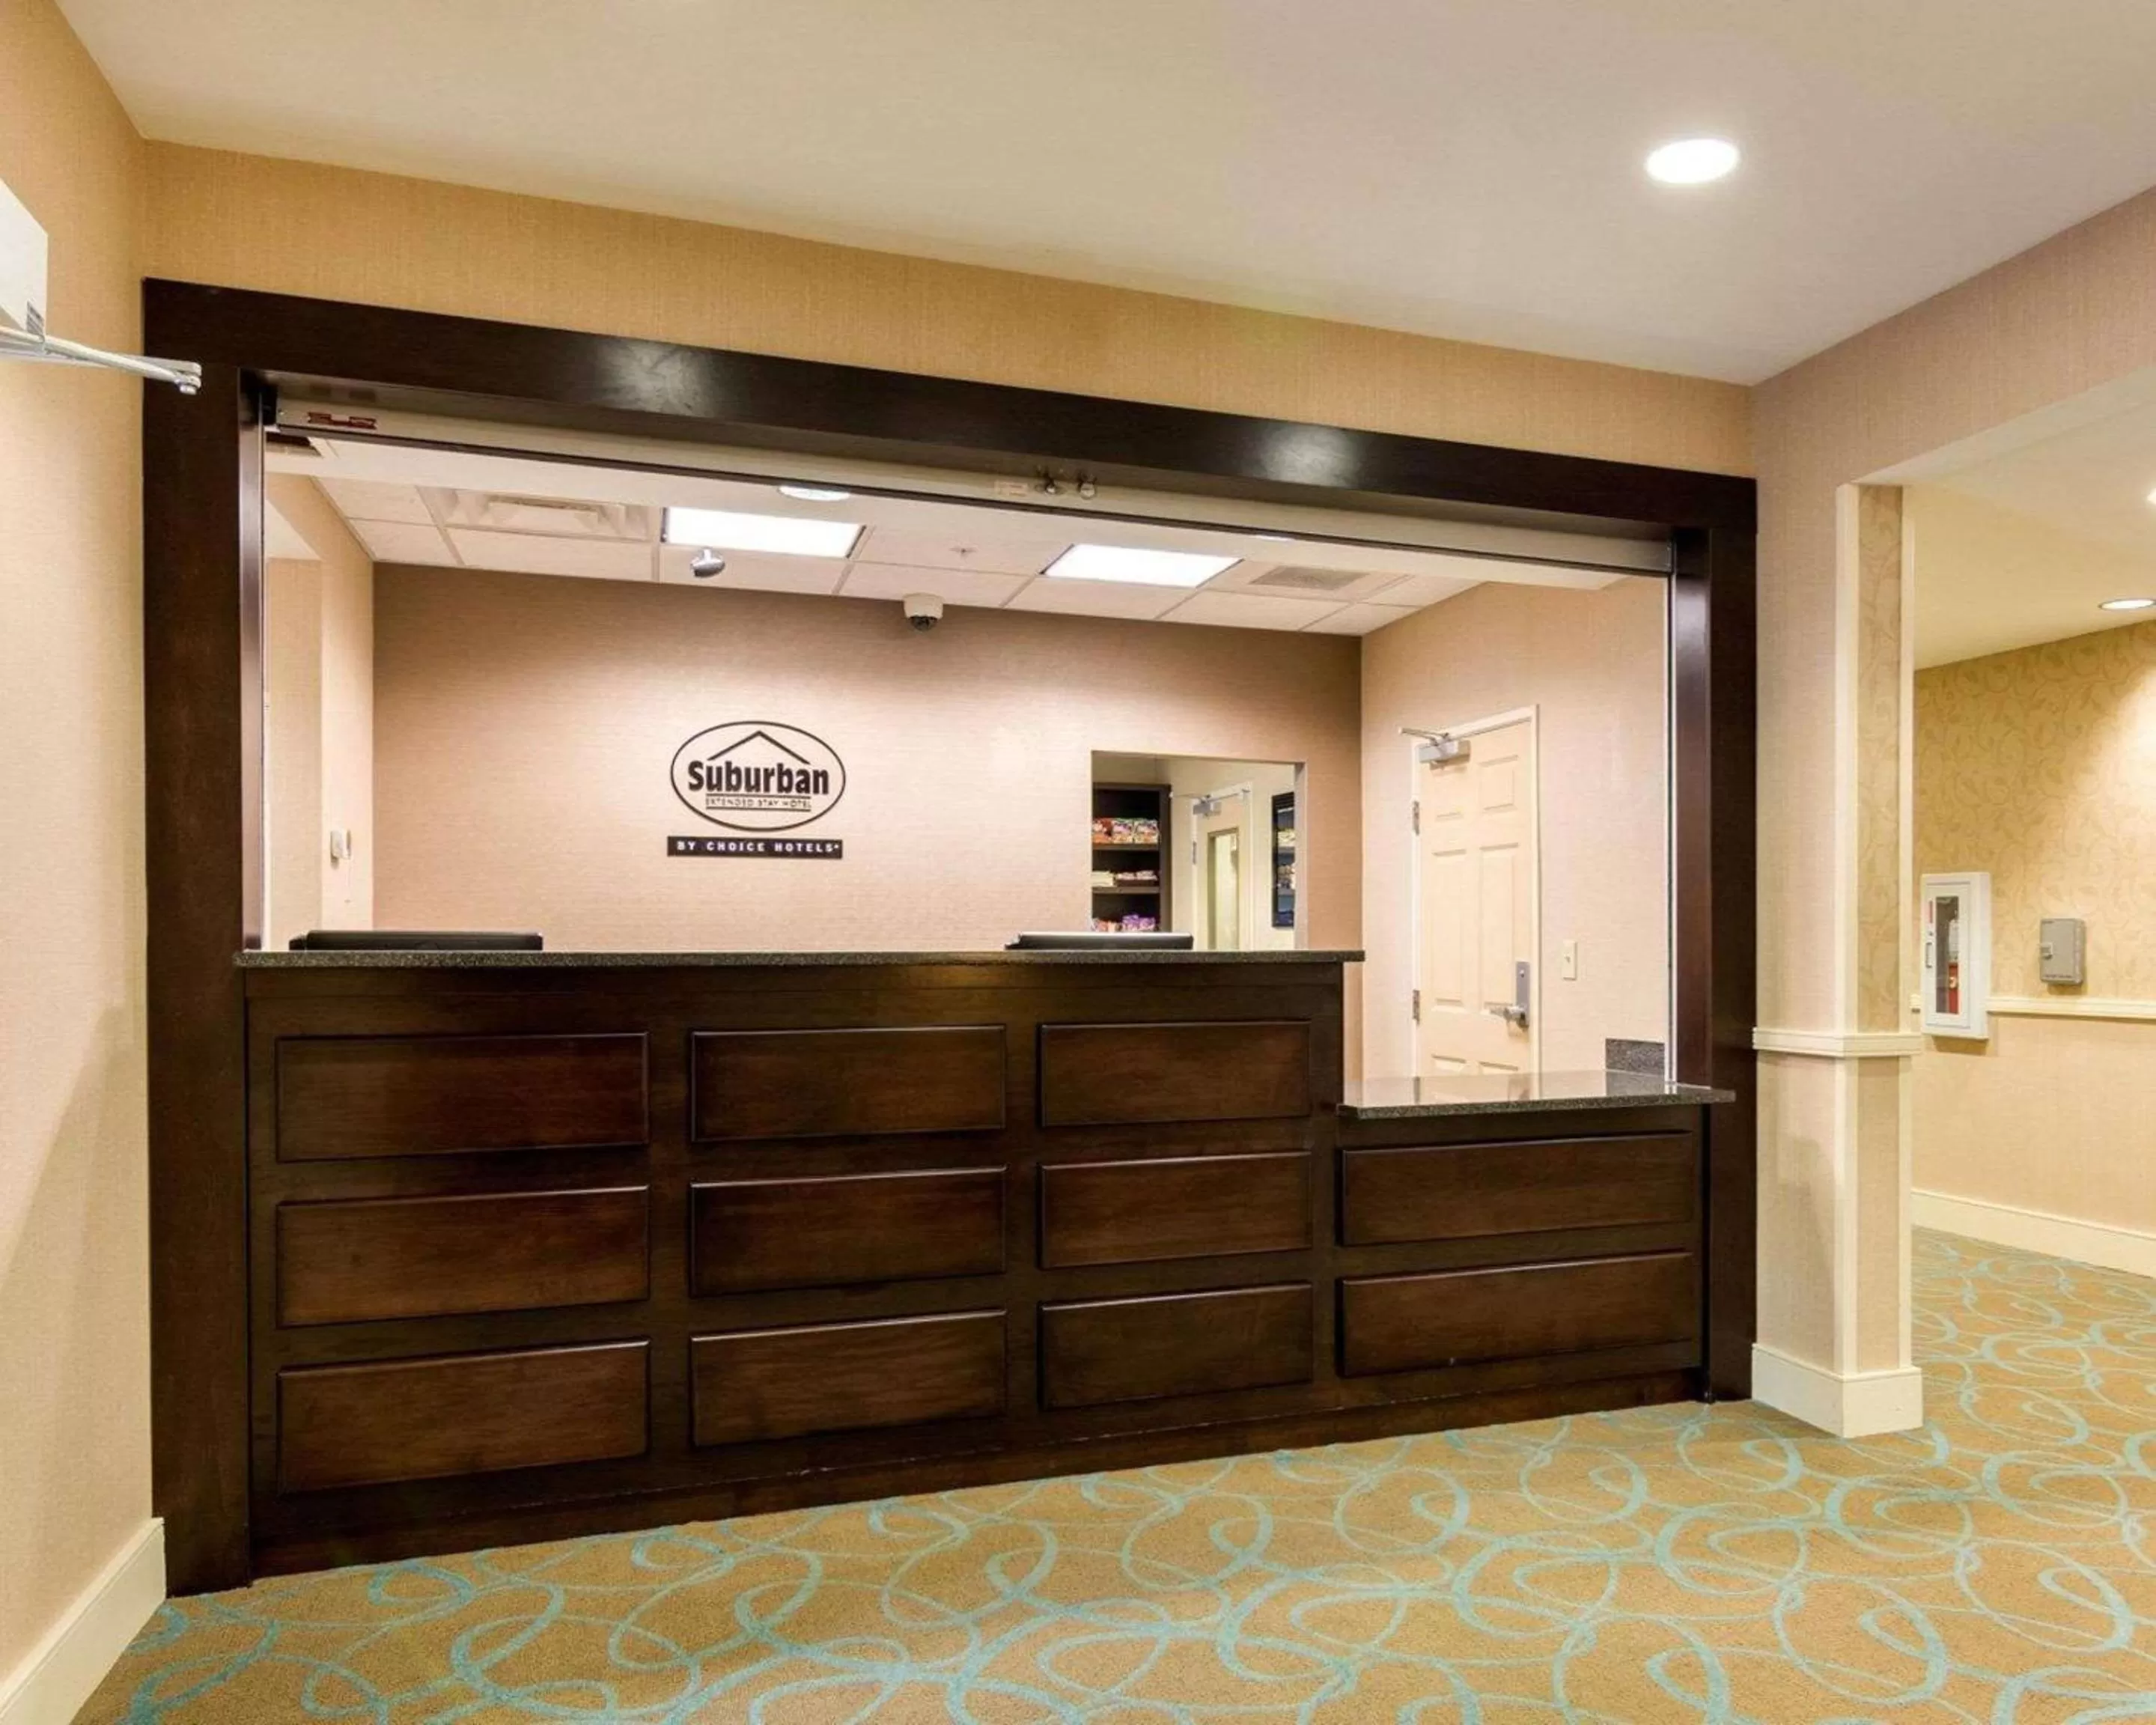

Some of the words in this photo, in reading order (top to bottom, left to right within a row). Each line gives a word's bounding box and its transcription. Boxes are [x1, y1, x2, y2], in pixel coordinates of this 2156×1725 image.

[687, 760, 829, 794] Suburban
[677, 841, 695, 851] BY
[706, 842, 765, 852] CHOICE
